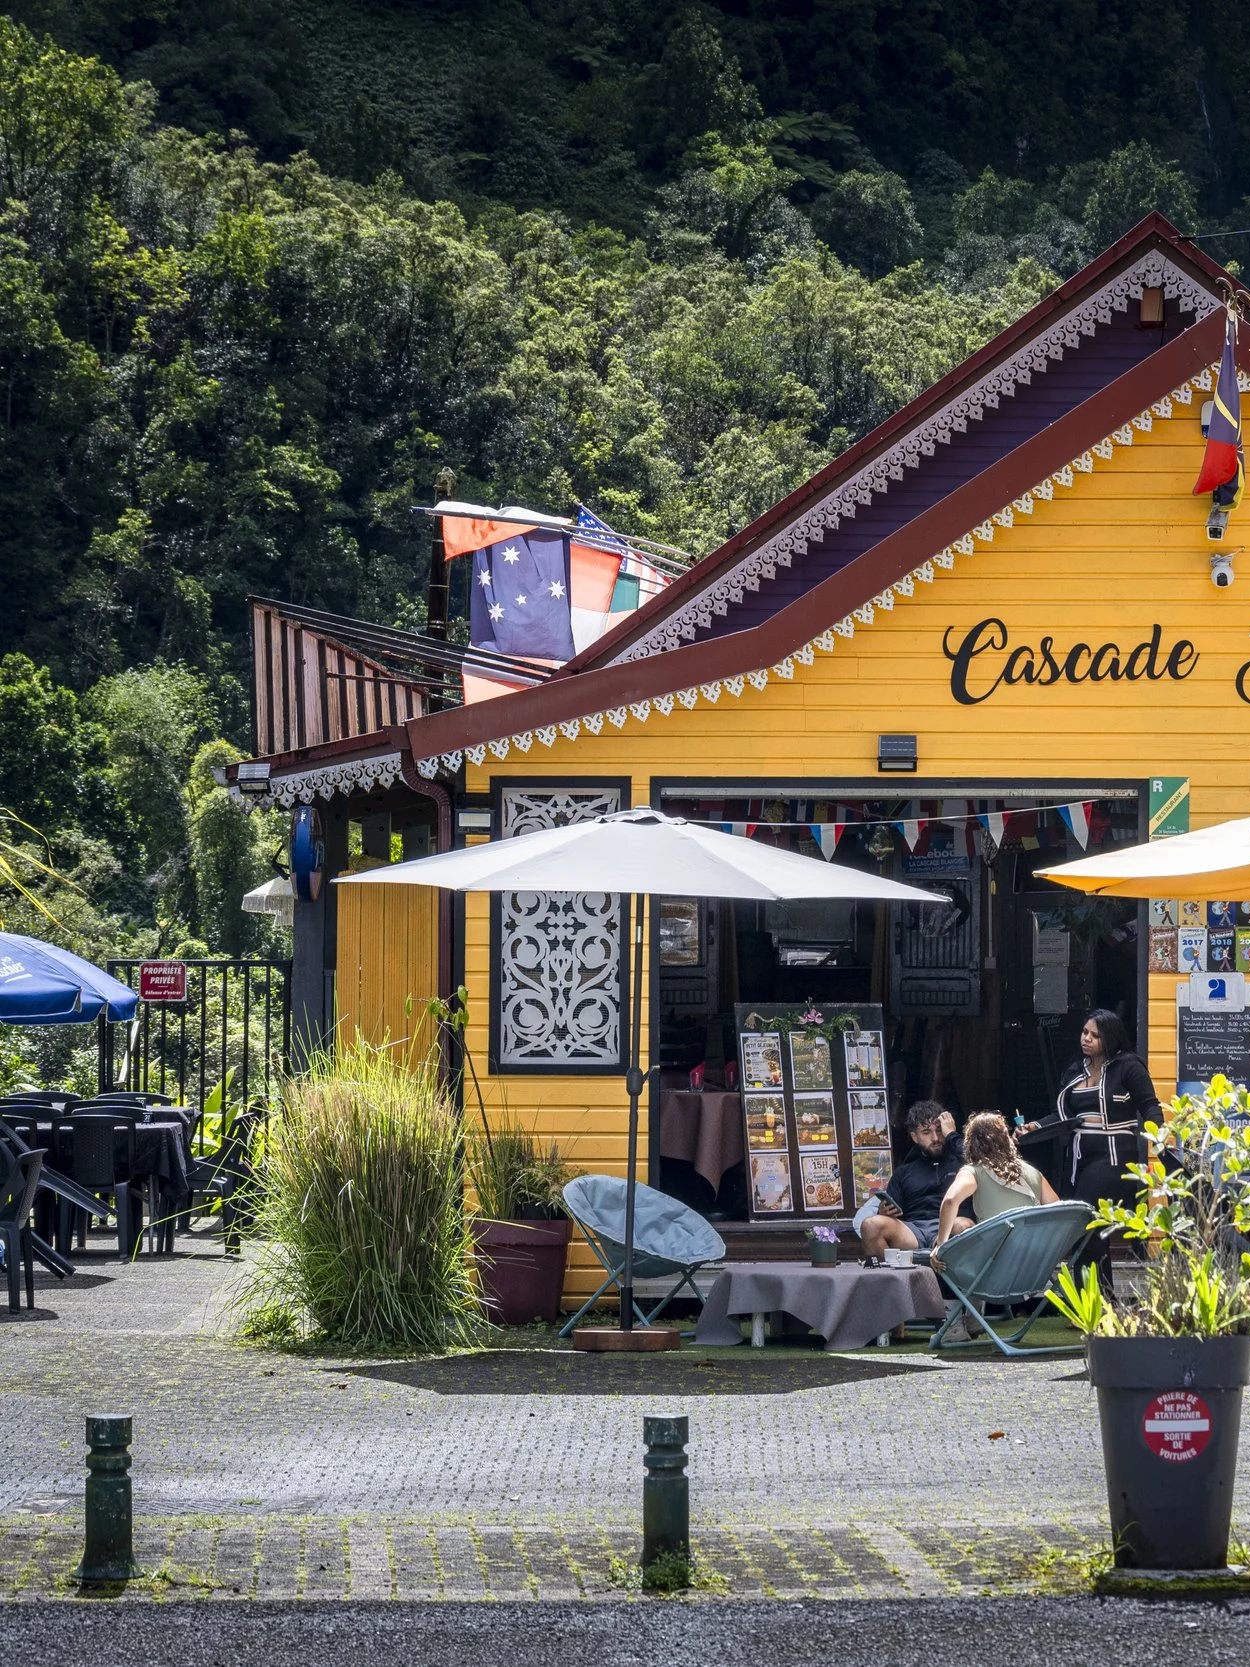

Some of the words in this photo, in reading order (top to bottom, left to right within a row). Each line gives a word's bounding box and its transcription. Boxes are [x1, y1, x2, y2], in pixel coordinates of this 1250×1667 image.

[943, 617, 1200, 705] Cascade
[1152, 780, 1163, 793] R
[1155, 791, 1183, 822] RESTAURANT
[143, 965, 183, 975] PROPRIÉTÉ
[150, 975, 176, 984] PRIVÉE
[812, 1161, 828, 1170] 15H
[1186, 1393, 1199, 1405] DE
[1163, 1403, 1175, 1412] NE
[1176, 1403, 1192, 1412] PAS
[1154, 1411, 1201, 1420] STATIONNER
[1163, 1432, 1192, 1441] SORTIE
[1172, 1440, 1184, 1449] DE
[1159, 1447, 1198, 1461] VOITURES
